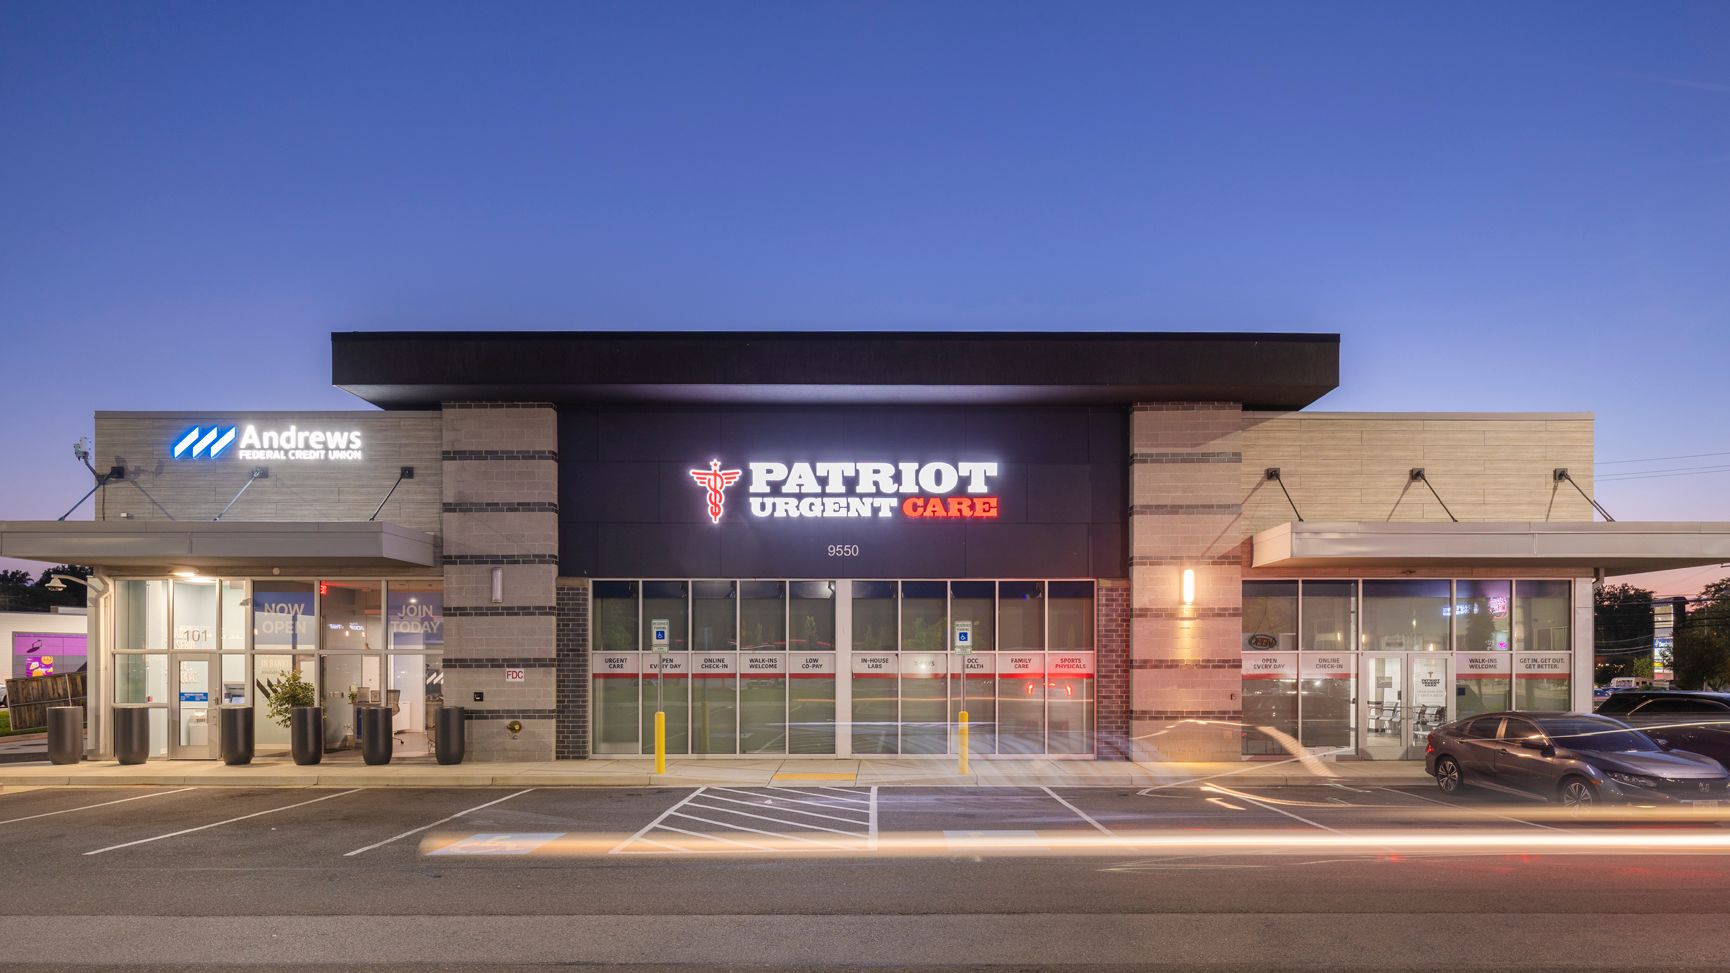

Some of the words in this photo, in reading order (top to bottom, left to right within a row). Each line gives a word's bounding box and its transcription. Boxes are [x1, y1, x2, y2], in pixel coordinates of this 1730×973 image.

[240, 425, 361, 449] Andrews
[239, 450, 286, 459] FEDERAL
[288, 450, 325, 459] CREDIT
[328, 450, 361, 459] UNION
[749, 462, 998, 493] PATRIOT
[749, 498, 897, 517] URGENT
[902, 497, 998, 517] CARE
[828, 545, 859, 556] 9550
[264, 603, 304, 616] NOW
[397, 604, 433, 617] JOIN
[262, 620, 307, 634] OPEN
[390, 620, 440, 633] TODAY
[184, 630, 207, 641] 101
[506, 670, 524, 679] FDC
